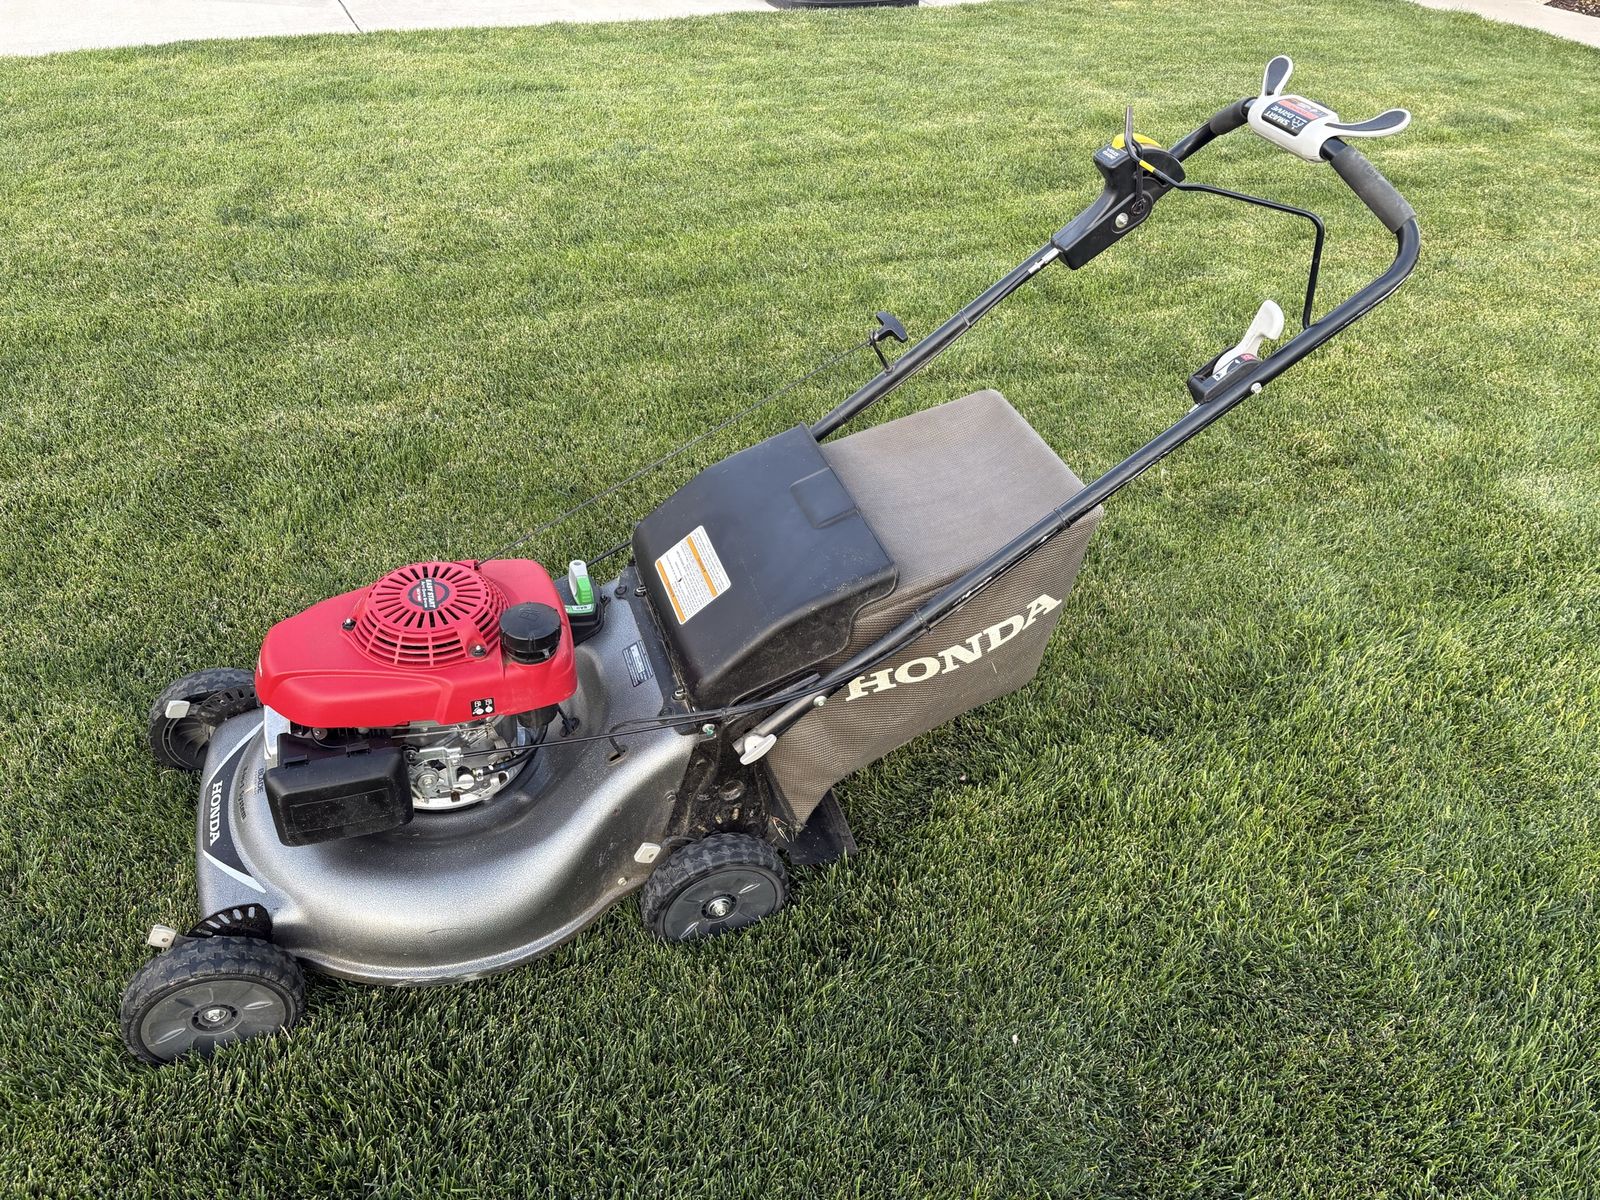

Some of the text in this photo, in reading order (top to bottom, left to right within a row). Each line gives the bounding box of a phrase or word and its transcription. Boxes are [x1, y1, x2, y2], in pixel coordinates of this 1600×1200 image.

[1264, 110, 1290, 126] SMART
[1271, 105, 1295, 119] DRIVE
[427, 592, 436, 608] START
[845, 593, 1063, 702] HONDA
[257, 767, 266, 794] BLADE
[209, 780, 223, 847] HONDA
